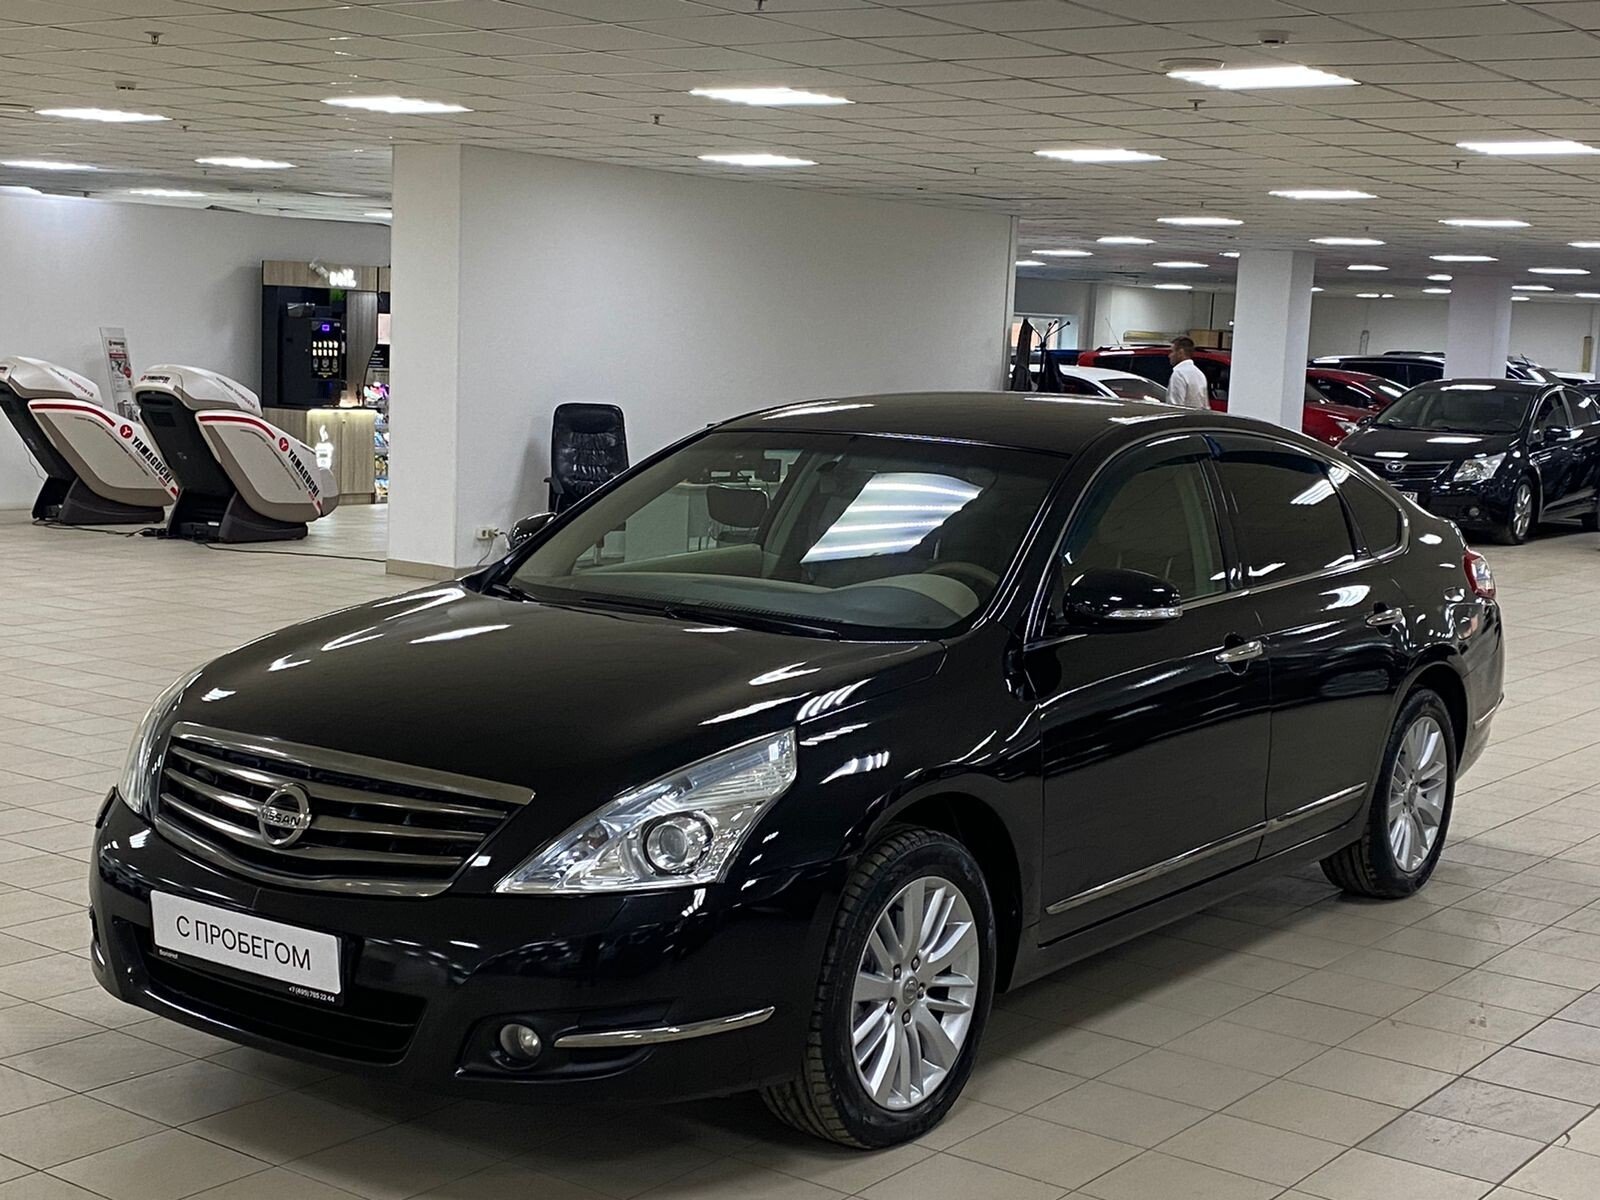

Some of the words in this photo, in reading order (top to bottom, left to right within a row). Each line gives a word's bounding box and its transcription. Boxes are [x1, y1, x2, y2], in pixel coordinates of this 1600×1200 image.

[131, 435, 173, 484] YAMAGUCHI
[288, 448, 320, 498] YAMAGUCHI
[176, 915, 190, 938] С
[195, 920, 311, 971] ПРОБЕГОМ
